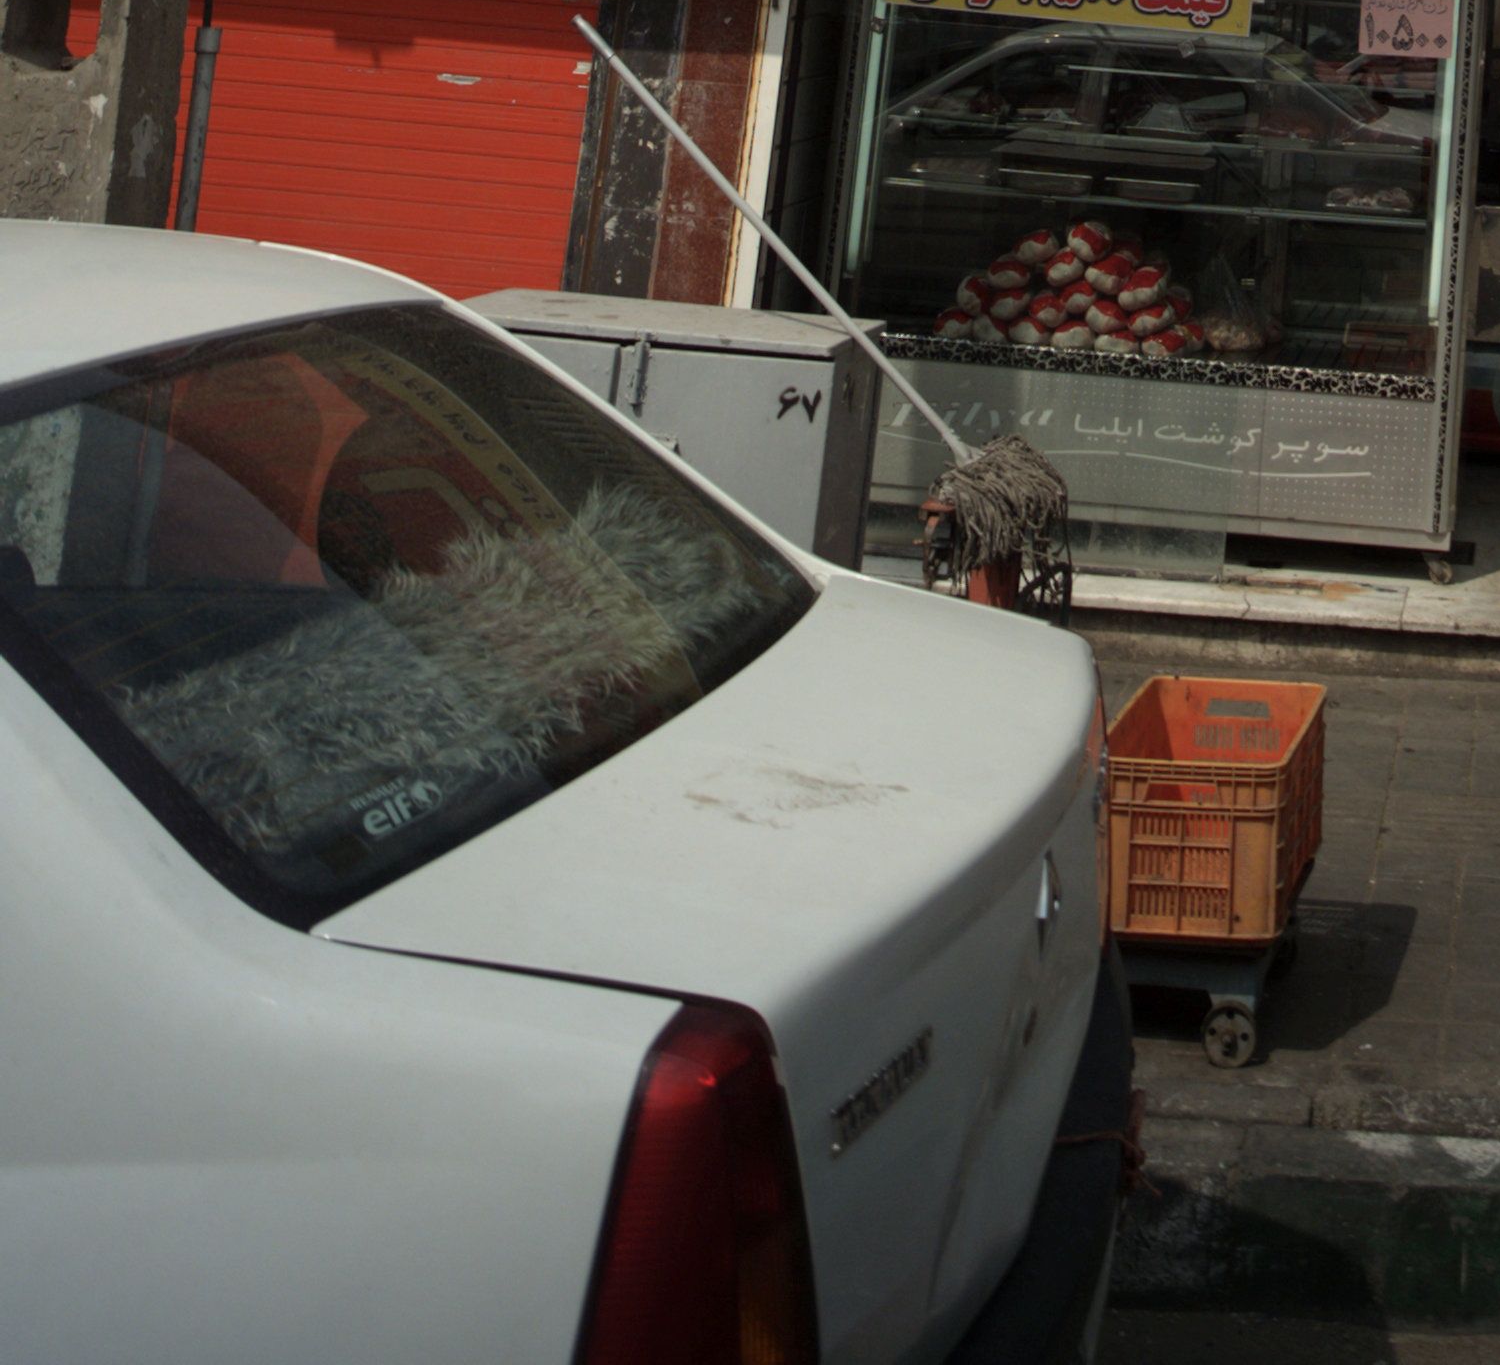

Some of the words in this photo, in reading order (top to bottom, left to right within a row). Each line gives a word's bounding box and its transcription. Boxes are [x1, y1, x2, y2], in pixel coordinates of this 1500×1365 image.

[1365, 12, 1447, 51] ۱۰۵۰۰
[776, 385, 822, 423] ۶۷
[1074, 413, 1143, 442] ایلیا
[1271, 439, 1371, 464] سوپر
